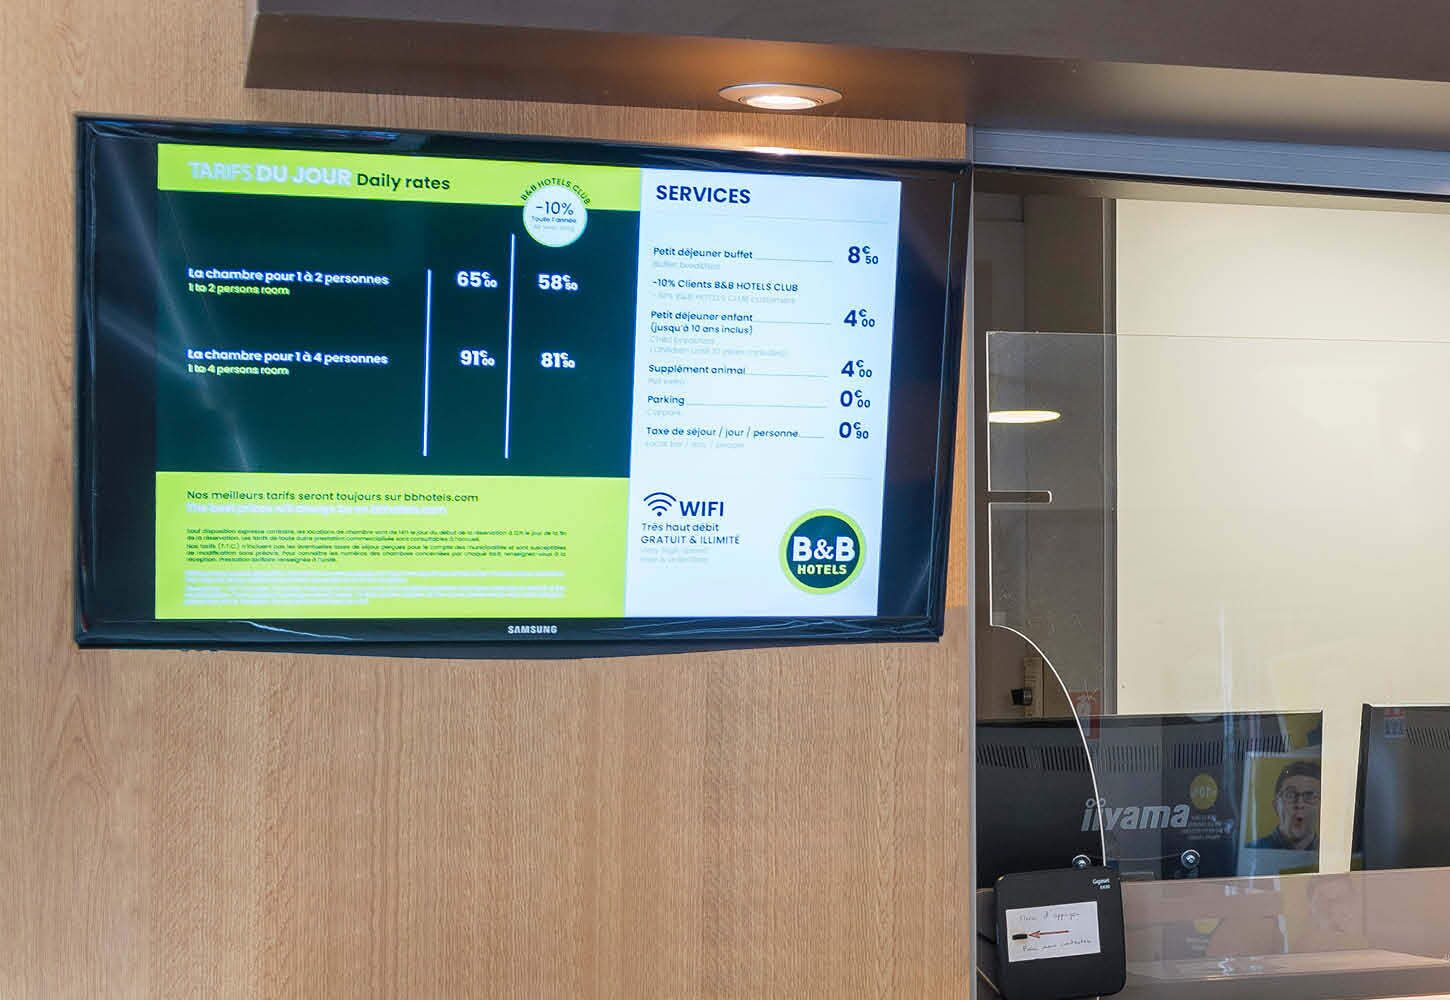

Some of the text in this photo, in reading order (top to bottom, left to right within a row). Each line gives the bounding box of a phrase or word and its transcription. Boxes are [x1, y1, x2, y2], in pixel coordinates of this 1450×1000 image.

[188, 161, 450, 191] TARIFS DU JOUR Daily rates
[537, 177, 572, 188] HOTELS
[656, 184, 751, 204] SERVICES
[535, 201, 574, 216] -10%
[653, 247, 676, 257] Petit
[678, 247, 722, 260] déjeuner
[724, 249, 753, 260] buffet
[187, 267, 204, 279] La
[206, 267, 263, 281] chambre
[265, 272, 295, 284] pour
[304, 271, 313, 282] à
[315, 272, 324, 283] 2
[325, 273, 390, 286] personnes
[194, 283, 208, 293] to
[208, 284, 217, 293] 2
[217, 285, 260, 296] persons
[261, 286, 290, 295] room
[652, 278, 799, 292] -10% Clients B&B HOTELS CLUB
[651, 310, 673, 320] Petit
[675, 311, 719, 322] déjeuner
[721, 312, 753, 322] enfant
[691, 324, 701, 333] 10
[702, 326, 720, 334] ans
[721, 325, 753, 336] inclus)
[187, 349, 204, 360] La
[205, 349, 262, 362] chambre
[264, 353, 295, 364] pour
[303, 351, 313, 362] à
[313, 352, 322, 363] 4
[324, 354, 389, 366] personnes
[194, 364, 207, 374] to
[207, 365, 216, 374] 4
[216, 366, 260, 376] persons
[261, 367, 289, 376] room
[648, 364, 709, 376] Supplément
[711, 365, 746, 375] animal
[647, 395, 685, 407] Parking
[646, 426, 670, 436] Taxe
[672, 426, 684, 436] de
[686, 426, 716, 438] séjour
[725, 429, 744, 438] jour
[753, 429, 798, 439] personne
[187, 490, 479, 502] Nos meilleurs tarifs seront toujours sur bbhotels.com
[679, 500, 724, 517] WIFI
[665, 522, 690, 532] haut
[692, 522, 720, 532] débit
[641, 535, 687, 544] GRATUIT
[689, 535, 697, 544] &
[792, 535, 856, 563] B&B
[797, 564, 847, 575] HOTELS
[507, 625, 558, 634] SAMSUNG
[1081, 797, 1191, 832] iiyama
